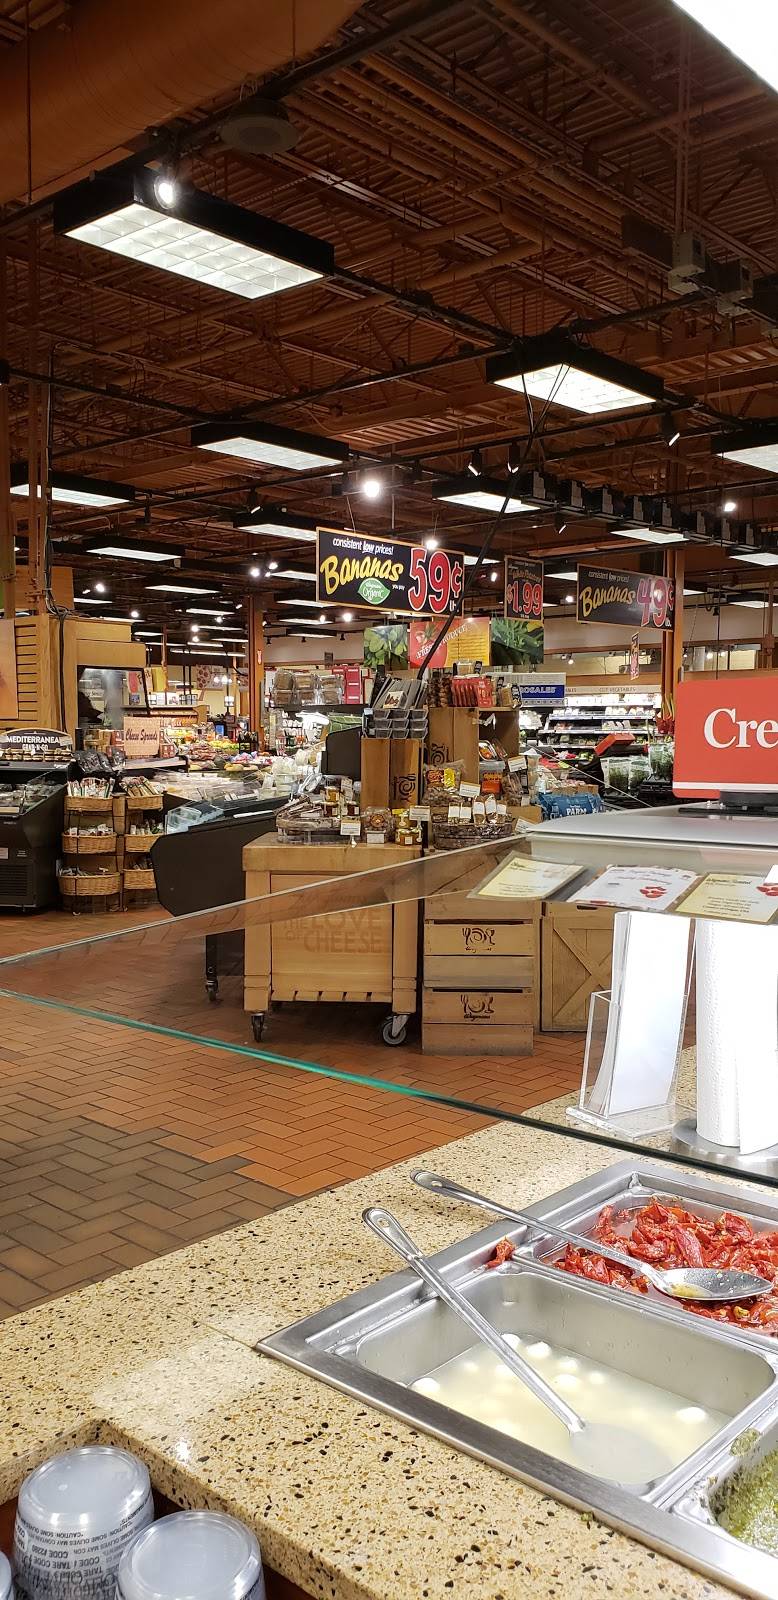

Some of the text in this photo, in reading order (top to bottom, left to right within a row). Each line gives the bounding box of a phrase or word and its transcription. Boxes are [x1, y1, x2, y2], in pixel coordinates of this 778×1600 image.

[332, 537, 394, 556] consistent low prices!
[320, 555, 404, 594] Bananas
[588, 572, 608, 580] consistent
[608, 572, 616, 582] low
[506, 581, 542, 616] $1.99
[580, 586, 636, 617] Bananas
[704, 708, 778, 748] Cre
[311, 910, 382, 929] LOVE
[304, 930, 382, 954] CHEESE
[48, 1550, 68, 1559] CODE
[80, 1556, 100, 1568] CODE
[52, 1560, 70, 1570] TARE
[84, 1566, 102, 1577] TARE
